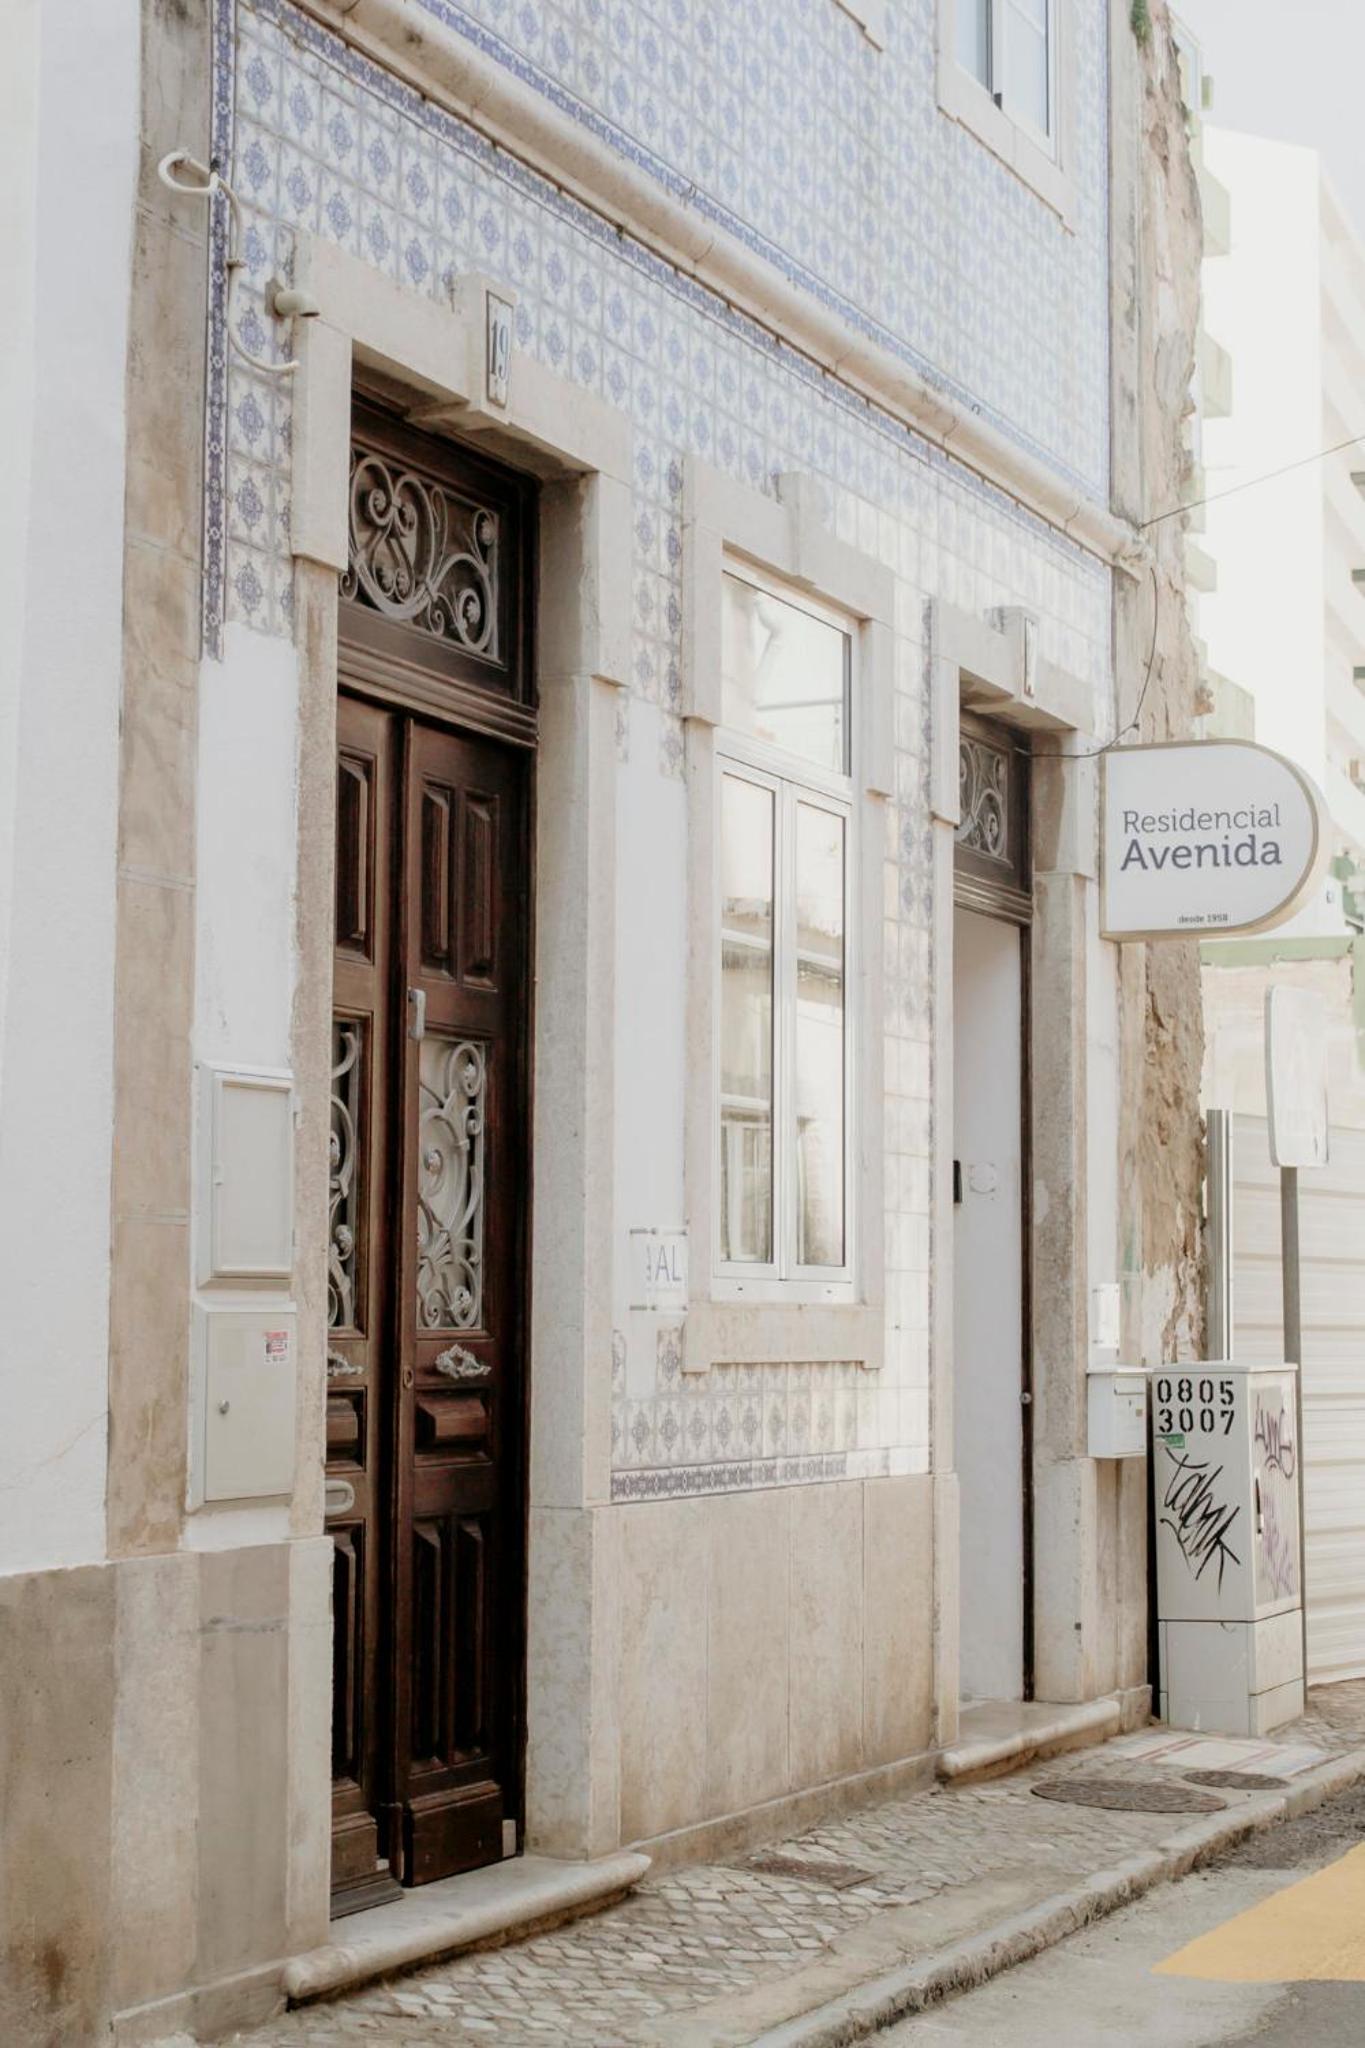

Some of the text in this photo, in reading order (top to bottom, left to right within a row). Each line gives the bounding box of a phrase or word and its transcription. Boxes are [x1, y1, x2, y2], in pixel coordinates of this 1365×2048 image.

[490, 319, 509, 380] 19
[1122, 803, 1281, 834] Residencial
[1120, 834, 1282, 871] Avenida
[1178, 914, 1204, 924] desde
[1157, 1378, 1234, 1405] 0805
[1158, 1408, 1235, 1435] 3007
